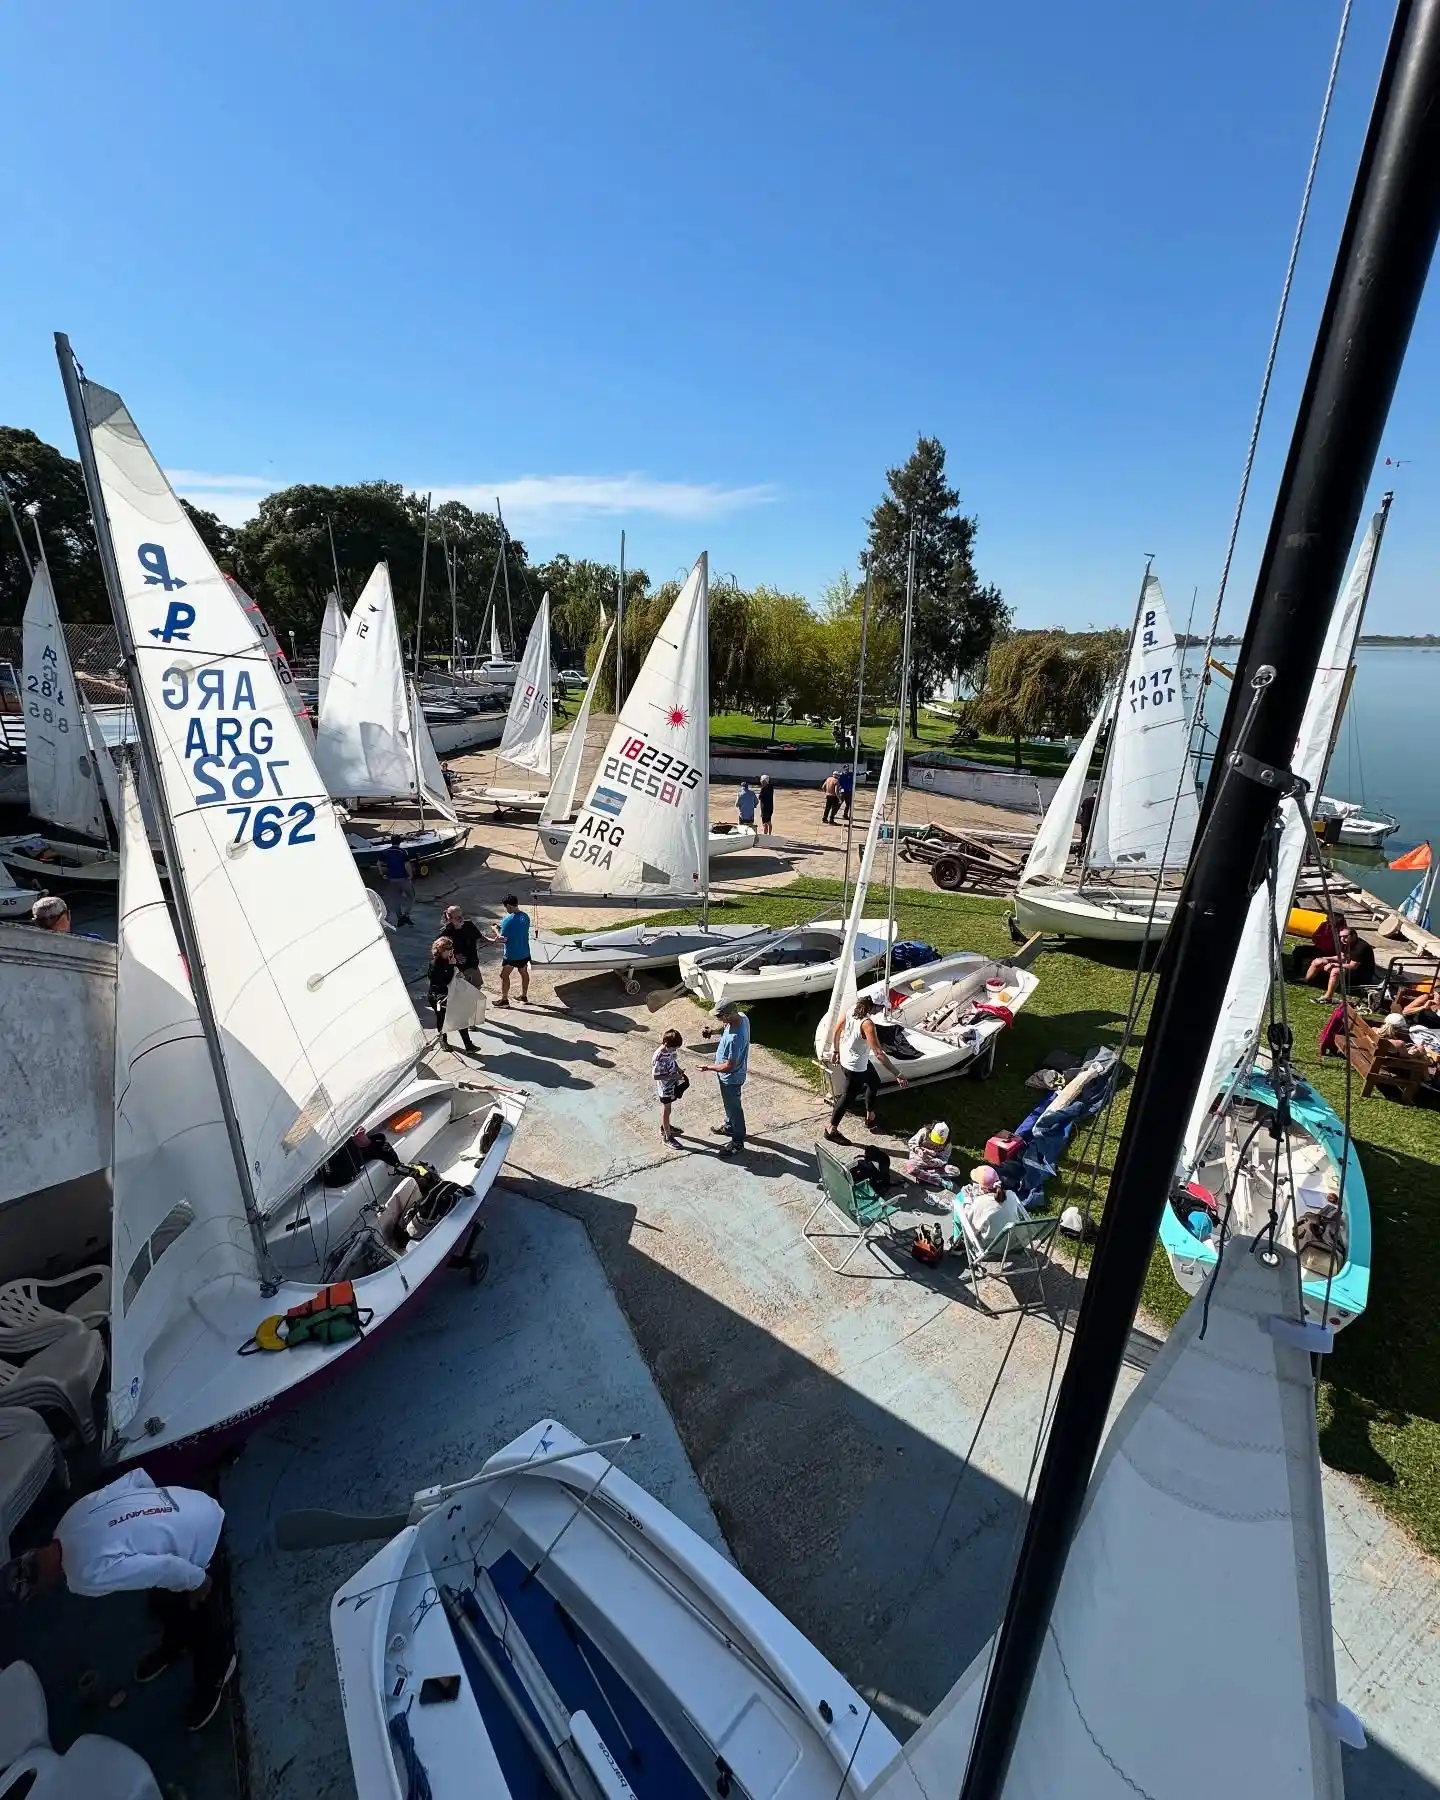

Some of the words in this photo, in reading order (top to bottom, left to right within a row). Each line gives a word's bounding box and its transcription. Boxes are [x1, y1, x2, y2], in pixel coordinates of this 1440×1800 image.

[1130, 668, 1172, 695] 1017
[185, 717, 273, 759] ARG
[620, 736, 702, 789] 182335
[227, 801, 316, 849] 762
[579, 816, 625, 847] ARG
[108, 1506, 173, 1528] EMIGRANTE
